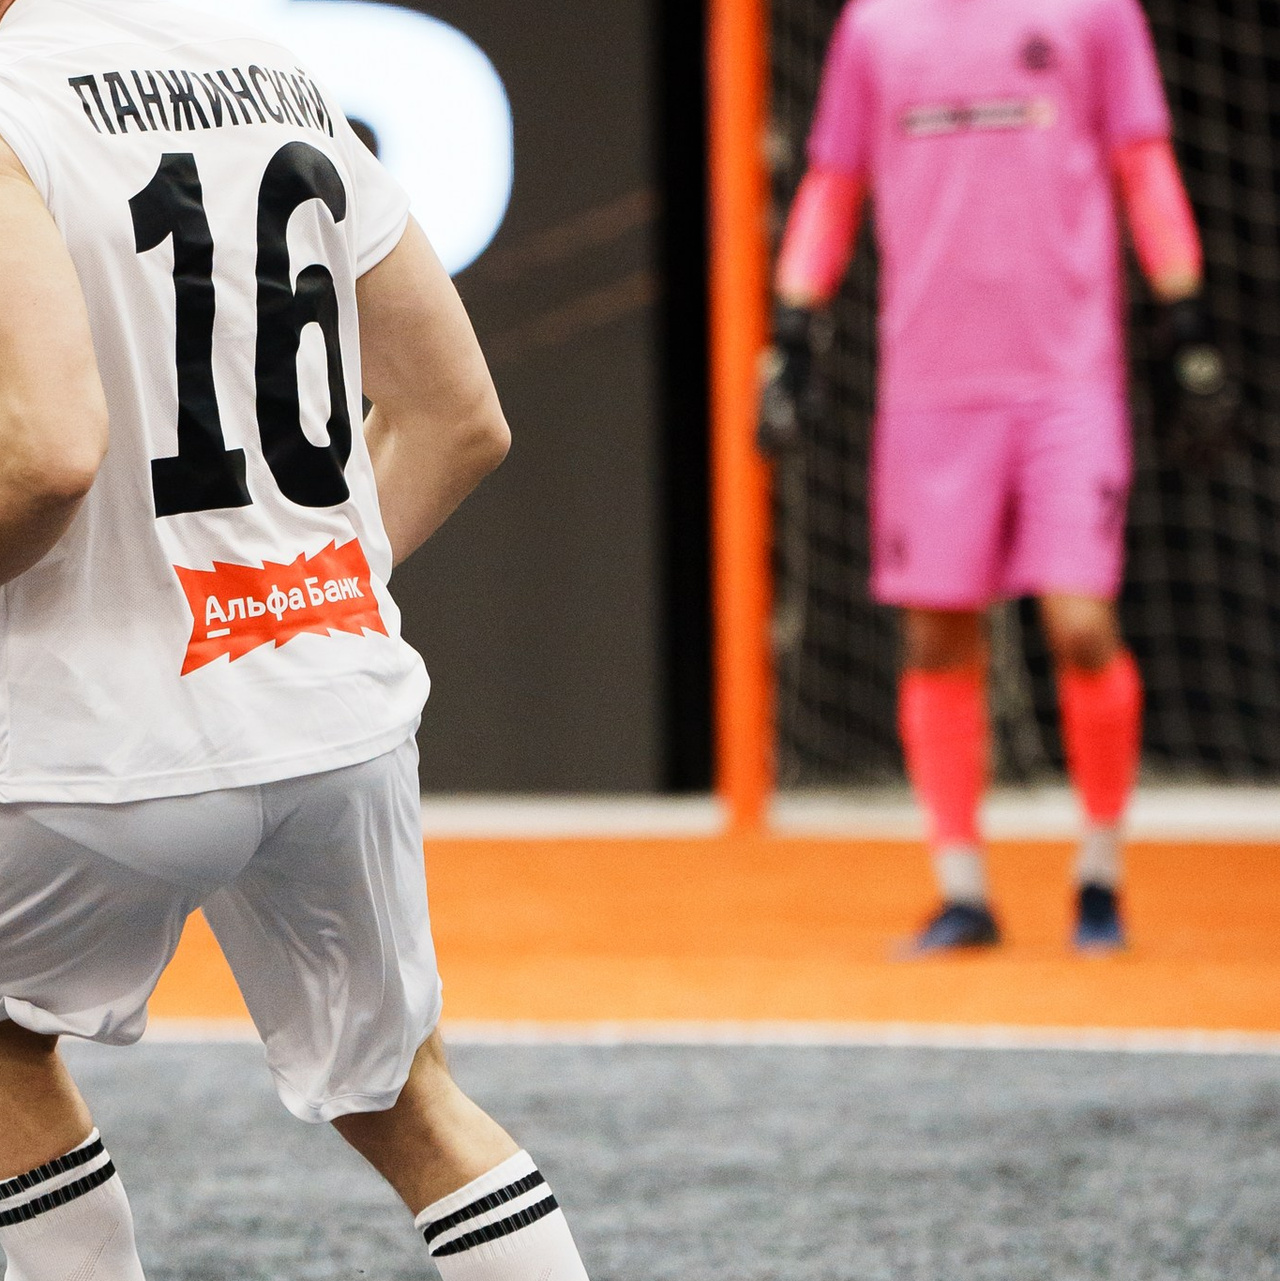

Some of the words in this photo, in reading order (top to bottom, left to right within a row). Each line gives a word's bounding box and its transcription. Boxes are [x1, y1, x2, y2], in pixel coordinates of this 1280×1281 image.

[68, 64, 334, 138] ПАНЖИНСКИЙ
[128, 141, 352, 519] 16
[205, 585, 306, 627] Альфа
[304, 576, 365, 607] Банк
